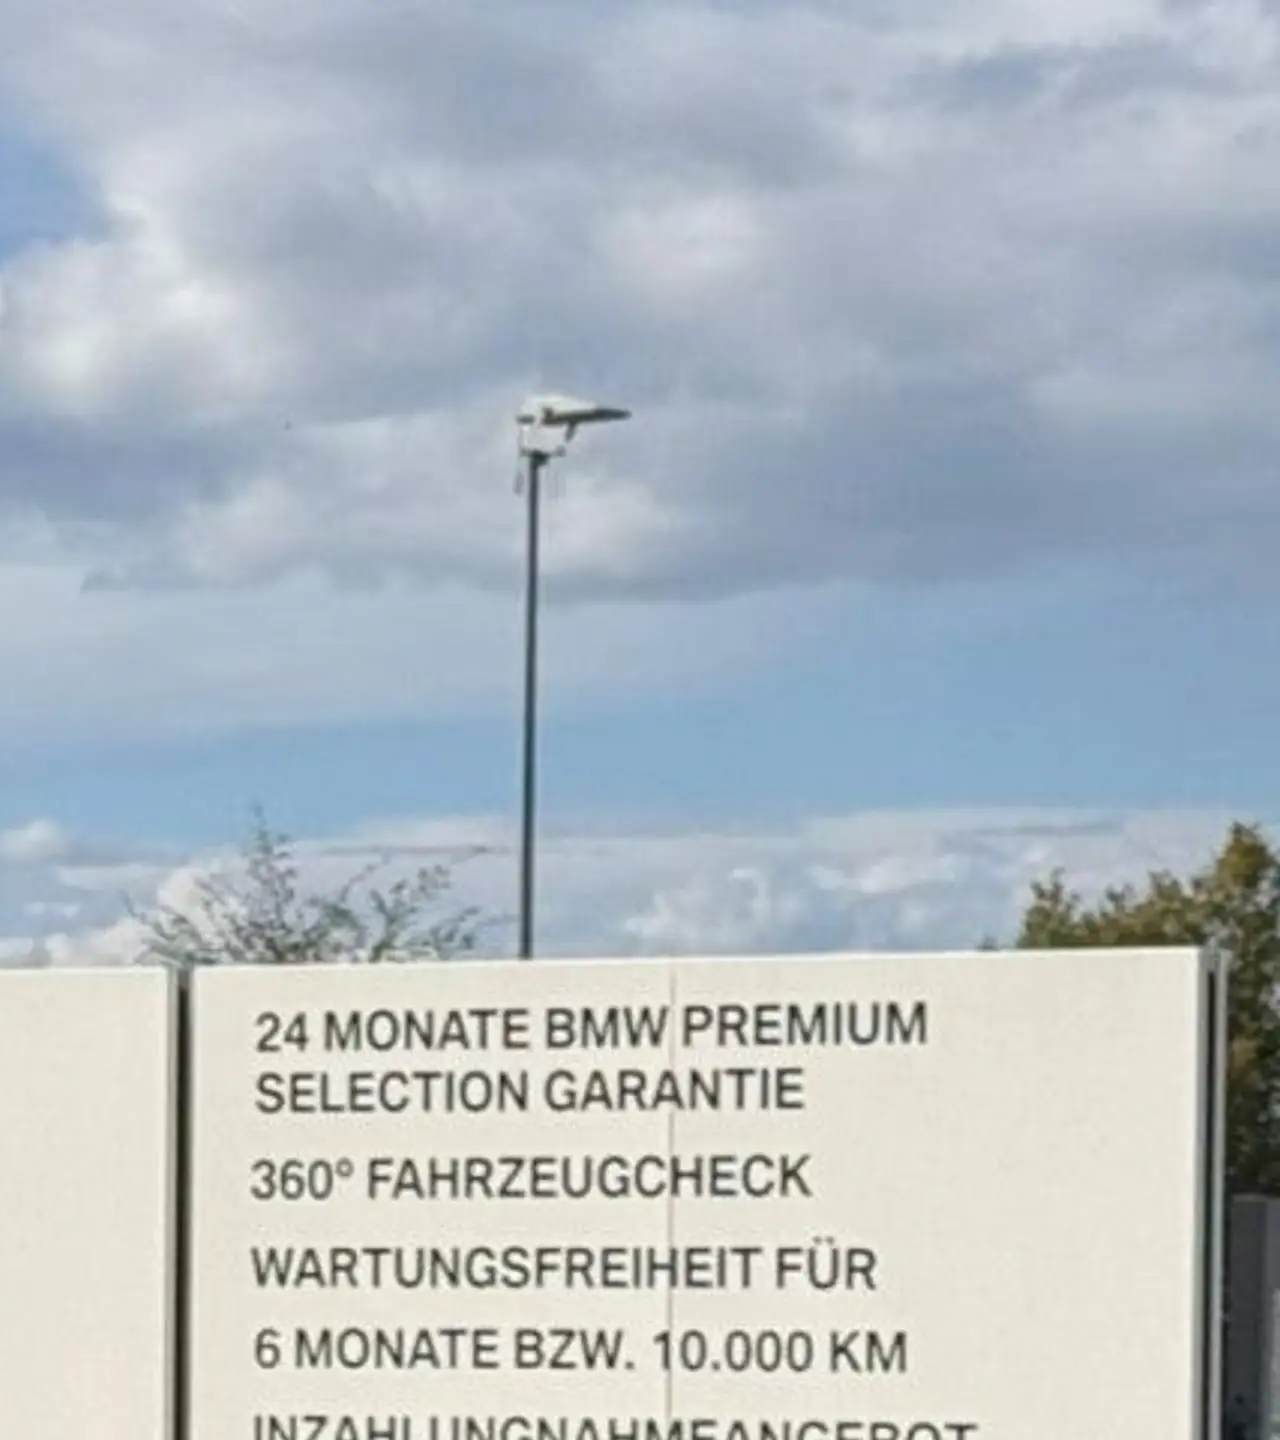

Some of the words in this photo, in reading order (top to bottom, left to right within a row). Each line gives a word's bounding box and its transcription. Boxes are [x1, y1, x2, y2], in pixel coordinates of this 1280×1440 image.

[256, 1011, 310, 1054] 24
[323, 1007, 530, 1052] MONATE
[545, 1005, 669, 1050] BMW
[682, 1000, 928, 1047] PREMIUM
[256, 1069, 529, 1115] SELECTION
[543, 1066, 805, 1113] GARANTIE
[250, 1158, 353, 1201] 360°
[367, 1153, 812, 1200] FAHRZEUGCHECK
[250, 1245, 763, 1290] WARTUNGSFREIHEIT
[775, 1236, 877, 1291] FÜR
[254, 1327, 281, 1370] 6
[295, 1326, 500, 1370] MONATE
[514, 1327, 635, 1371] BZW.
[653, 1329, 814, 1374] 10.000
[829, 1330, 907, 1373] KM
